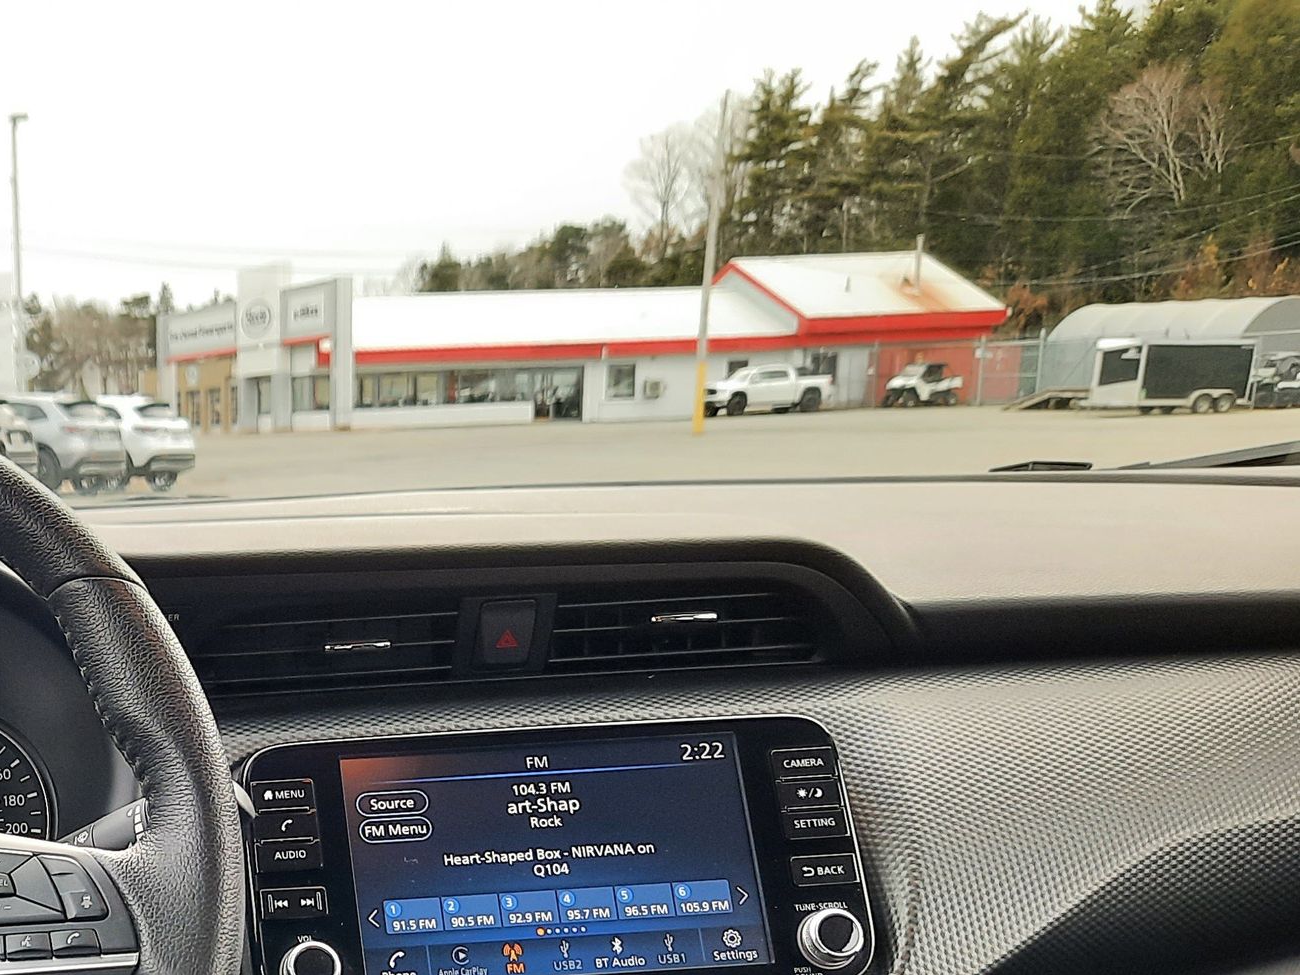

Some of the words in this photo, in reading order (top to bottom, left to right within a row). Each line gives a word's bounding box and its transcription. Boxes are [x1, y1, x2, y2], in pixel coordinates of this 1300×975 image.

[680, 742, 725, 761] 2:22
[525, 756, 549, 769] FM
[783, 757, 824, 768] CAMERA
[275, 789, 305, 799] MENU
[512, 783, 546, 796] 104.3
[550, 781, 571, 794] FM
[3, 795, 25, 806] 180
[370, 797, 415, 810] Source
[507, 797, 580, 814] art-Shap
[530, 816, 563, 828] Rock
[793, 817, 836, 829] SETTING
[5, 823, 28, 834] 200
[364, 825, 385, 837] FM
[388, 823, 427, 836] Menu
[274, 849, 307, 860] AUDIO
[444, 850, 533, 867] Heart-Shaped
[537, 849, 562, 861] Box
[571, 844, 635, 857] NIRVANA
[637, 845, 655, 855] on
[533, 864, 569, 878] Q104
[817, 865, 845, 876] BACK
[620, 890, 629, 900] 5
[678, 886, 687, 896] 6
[505, 897, 513, 907] 3
[563, 894, 571, 903] 4
[389, 905, 397, 914] 1
[447, 901, 456, 911] 2
[624, 906, 649, 917] 96.5
[650, 904, 669, 915] FM
[680, 901, 710, 913] 105.9
[711, 900, 730, 911] FM
[509, 912, 533, 924] 92.9
[535, 911, 553, 922] FM
[567, 908, 590, 920] 95.7
[592, 907, 610, 918] FM
[392, 920, 417, 931] 91.5
[418, 919, 437, 930] FM
[451, 916, 475, 928] 90.5
[477, 915, 495, 926] FM
[595, 957, 611, 968] BT
[612, 956, 646, 968] Audio
[658, 953, 686, 964] USB1
[713, 949, 758, 963] Settings
[506, 963, 525, 975] FM
[553, 960, 582, 971] USB2
